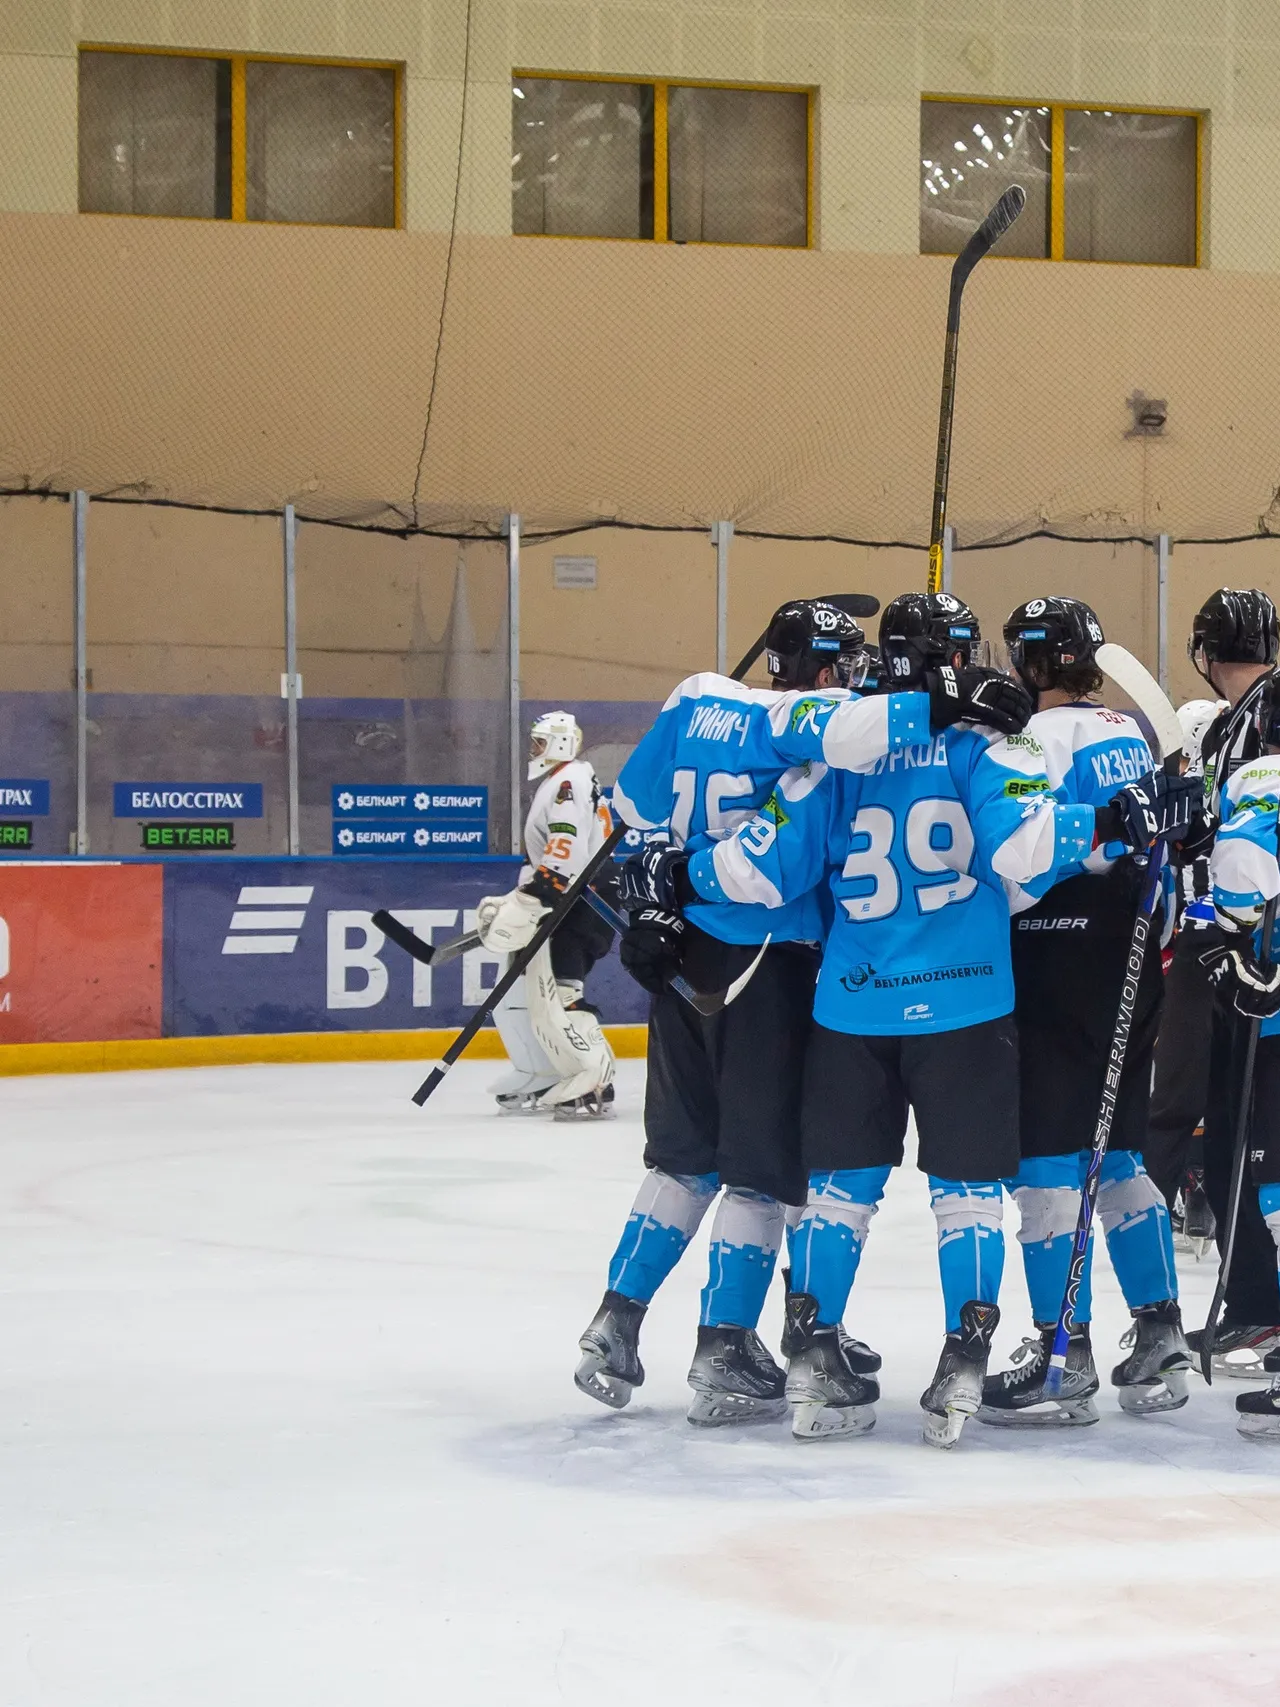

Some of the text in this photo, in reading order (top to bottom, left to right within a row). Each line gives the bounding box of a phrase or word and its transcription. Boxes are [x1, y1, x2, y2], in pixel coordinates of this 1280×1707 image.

[893, 657, 910, 676] 39
[132, 792, 244, 808] БЕЛГОССТРАХ
[356, 796, 483, 808] БЕЛКАРТ БЕЛКАРТ
[147, 828, 230, 845] BETERA
[356, 832, 482, 843] БЕЛКАРТ БЕЛКАРТ
[840, 799, 978, 920] 39
[874, 964, 994, 989] BELTAMOZHSERVICE
